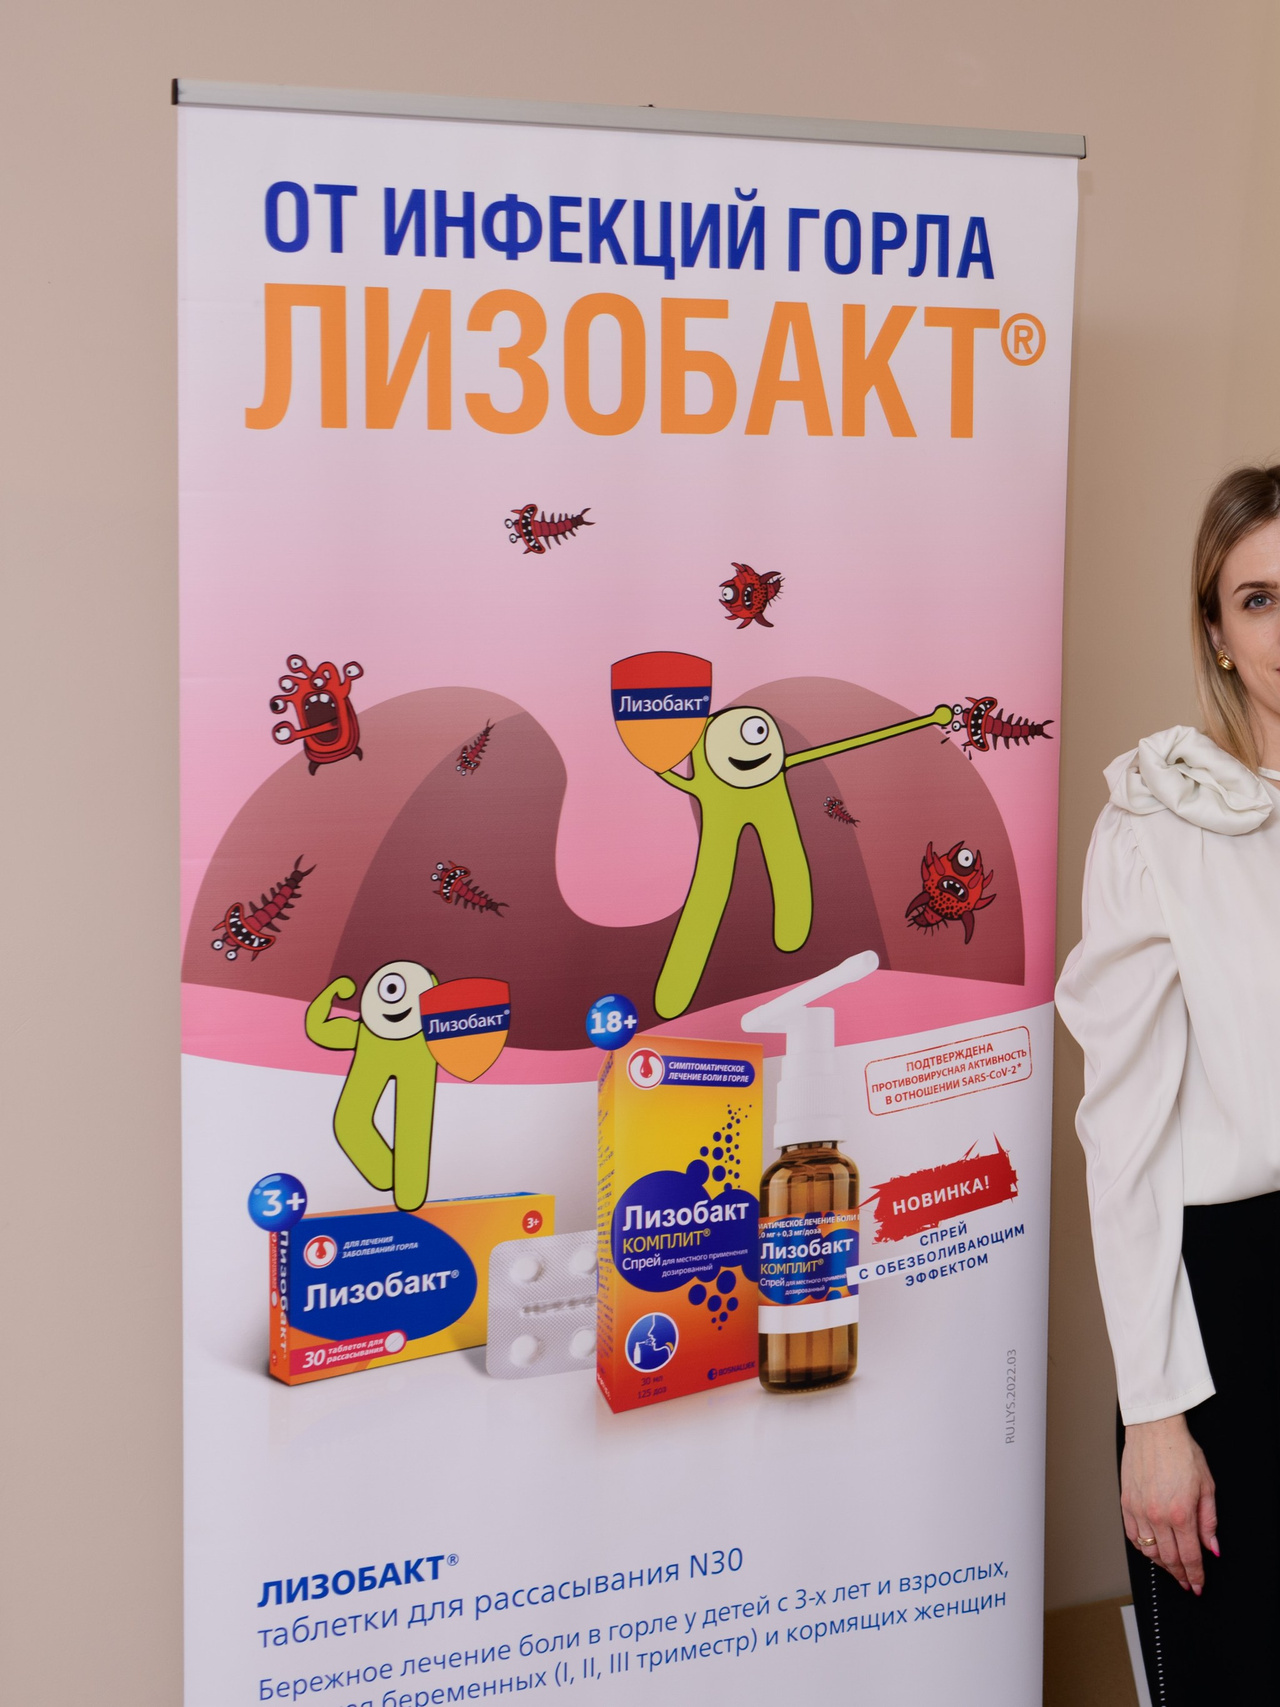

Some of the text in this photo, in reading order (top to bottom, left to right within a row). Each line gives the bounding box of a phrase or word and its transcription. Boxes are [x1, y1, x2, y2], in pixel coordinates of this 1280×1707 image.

[264, 180, 995, 281] ОТ ИНФЕКЦИЙ ГОРЛА
[244, 282, 1046, 439] ЛИЗОБАКТ®
[619, 694, 709, 712] Лизобакт®
[590, 1011, 637, 1034] 18+
[668, 1061, 745, 1073] СИМПТОМАТИЧЕСКОЕ
[906, 1043, 994, 1072] ПОДТВЕРЖДЕНА
[668, 1072, 702, 1081] ЛЕЧЕНИЕ
[702, 1073, 722, 1082] БОЛИ
[728, 1075, 749, 1083] ГОРЛЕ
[872, 1049, 1027, 1093] ПРОТИВОВИРУСНАЯ АКТИВНОСТЬ
[885, 1095, 893, 1105] В
[894, 1079, 961, 1103] ОТНОШЕНИИ
[262, 1189, 305, 1217] 3+
[893, 1175, 990, 1215] НОВИНКА!
[526, 1217, 540, 1229] 3+
[622, 1200, 750, 1232] Лизобакт
[804, 1216, 835, 1226] ЛЕЧЕНИЕ
[836, 1213, 857, 1222] БОЛИ
[343, 1235, 394, 1250] ДЛЯ ЛЕЧЕНИЯ
[623, 1228, 711, 1254] КОМПЛИТ®
[782, 1230, 793, 1238] 0,3
[793, 1228, 822, 1237] мг/доза
[920, 1220, 968, 1246] СПРЕЙ
[342, 1242, 419, 1259] ЗАБОЛЕВАНИЙ ГОРЛА
[622, 1249, 748, 1271] Спрей для местного применения
[760, 1238, 854, 1259] Лизобакт
[859, 1224, 1025, 1280] С ОБЕЗБОЛИВАЮЩИМ
[662, 1263, 713, 1278] дозированный
[760, 1258, 824, 1275] КОМПЛИТ®
[905, 1253, 989, 1286] ЭФФЕКТОМ
[303, 1269, 459, 1312] Лизобакт®
[760, 1277, 785, 1288] Спрей
[785, 1285, 825, 1295] дозированный
[302, 1338, 384, 1368] 30 таблеток для
[326, 1346, 384, 1365] рассасывания
[638, 1386, 667, 1399] 125 доз
[641, 1377, 651, 1386] 30
[1005, 1349, 1016, 1444] RU.LYS.2022.03
[257, 1553, 459, 1607] ЛИЗОБАКТ®
[258, 1548, 743, 1648] таблетки для рассасывания N30
[259, 1560, 1009, 1702] Бережное лечение боли в горле у детей с 3-х лет и взрослых,
[382, 1591, 1006, 1707] беременных (I, II, III триместр) и кормящих женщин
